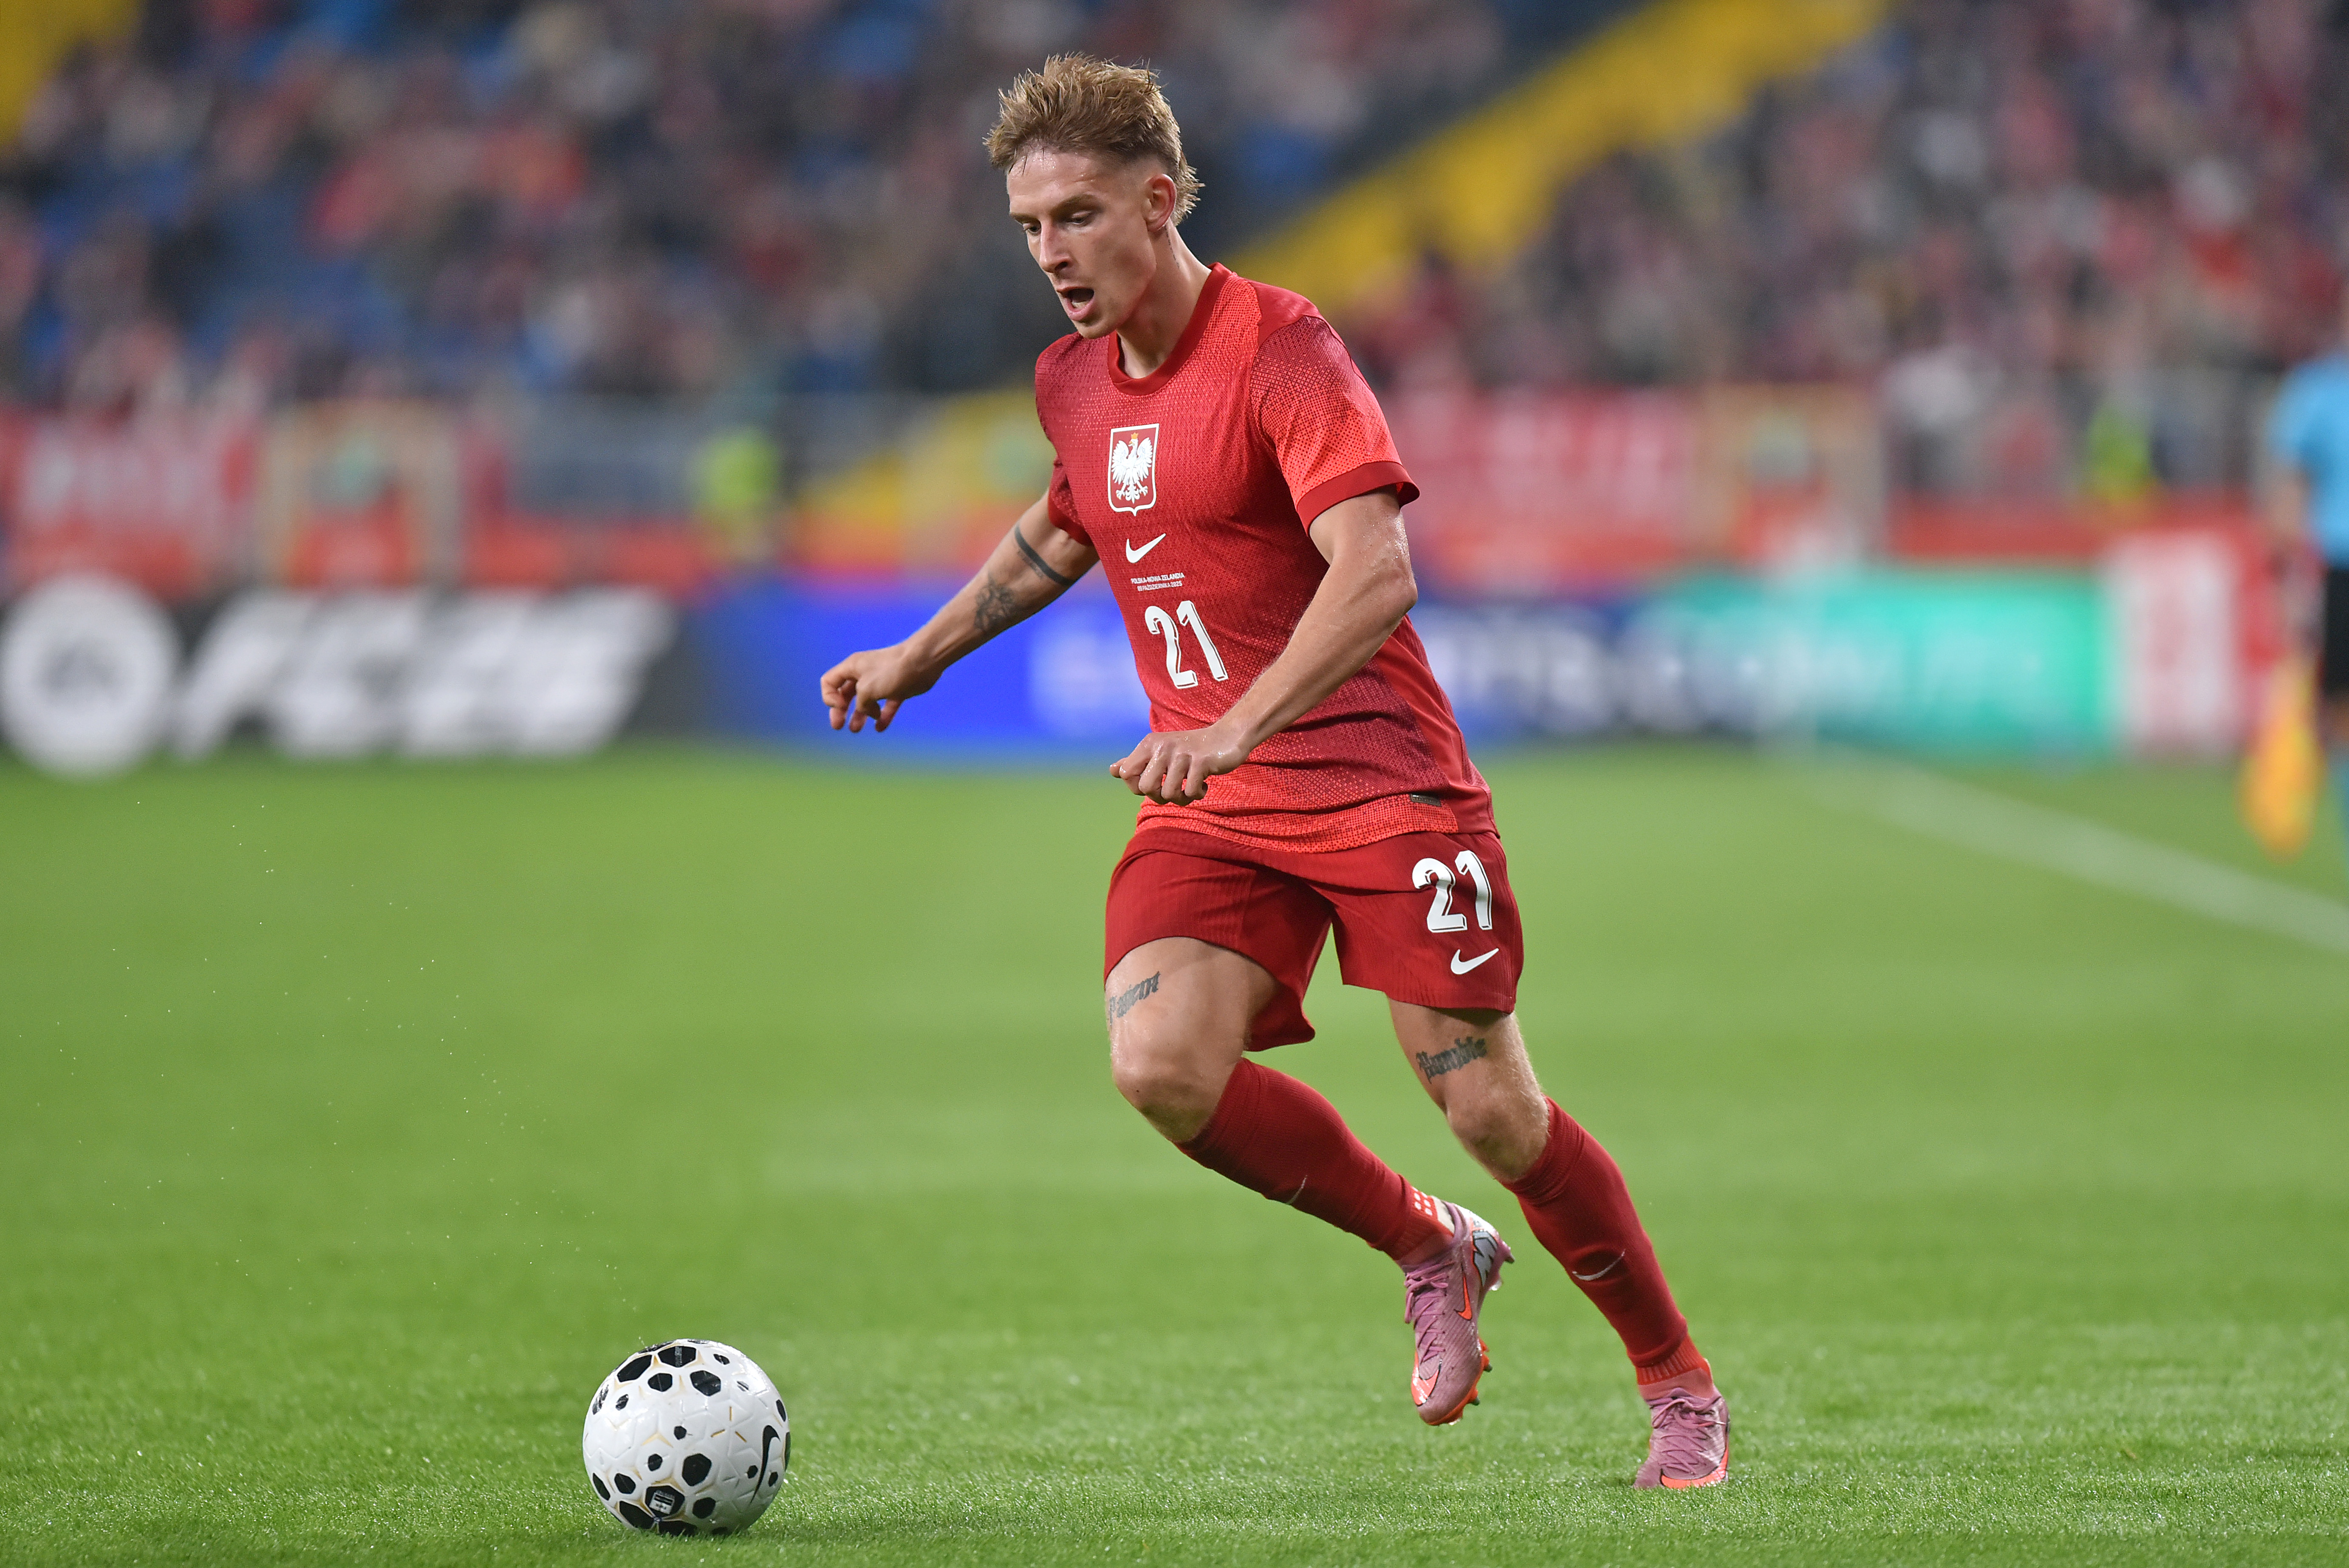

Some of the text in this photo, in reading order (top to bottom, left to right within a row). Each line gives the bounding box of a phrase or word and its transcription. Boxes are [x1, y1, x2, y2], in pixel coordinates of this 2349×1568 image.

[1160, 572, 1185, 581] ZELANDIA
[1145, 600, 1229, 689] 21
[1412, 850, 1492, 932] 21
